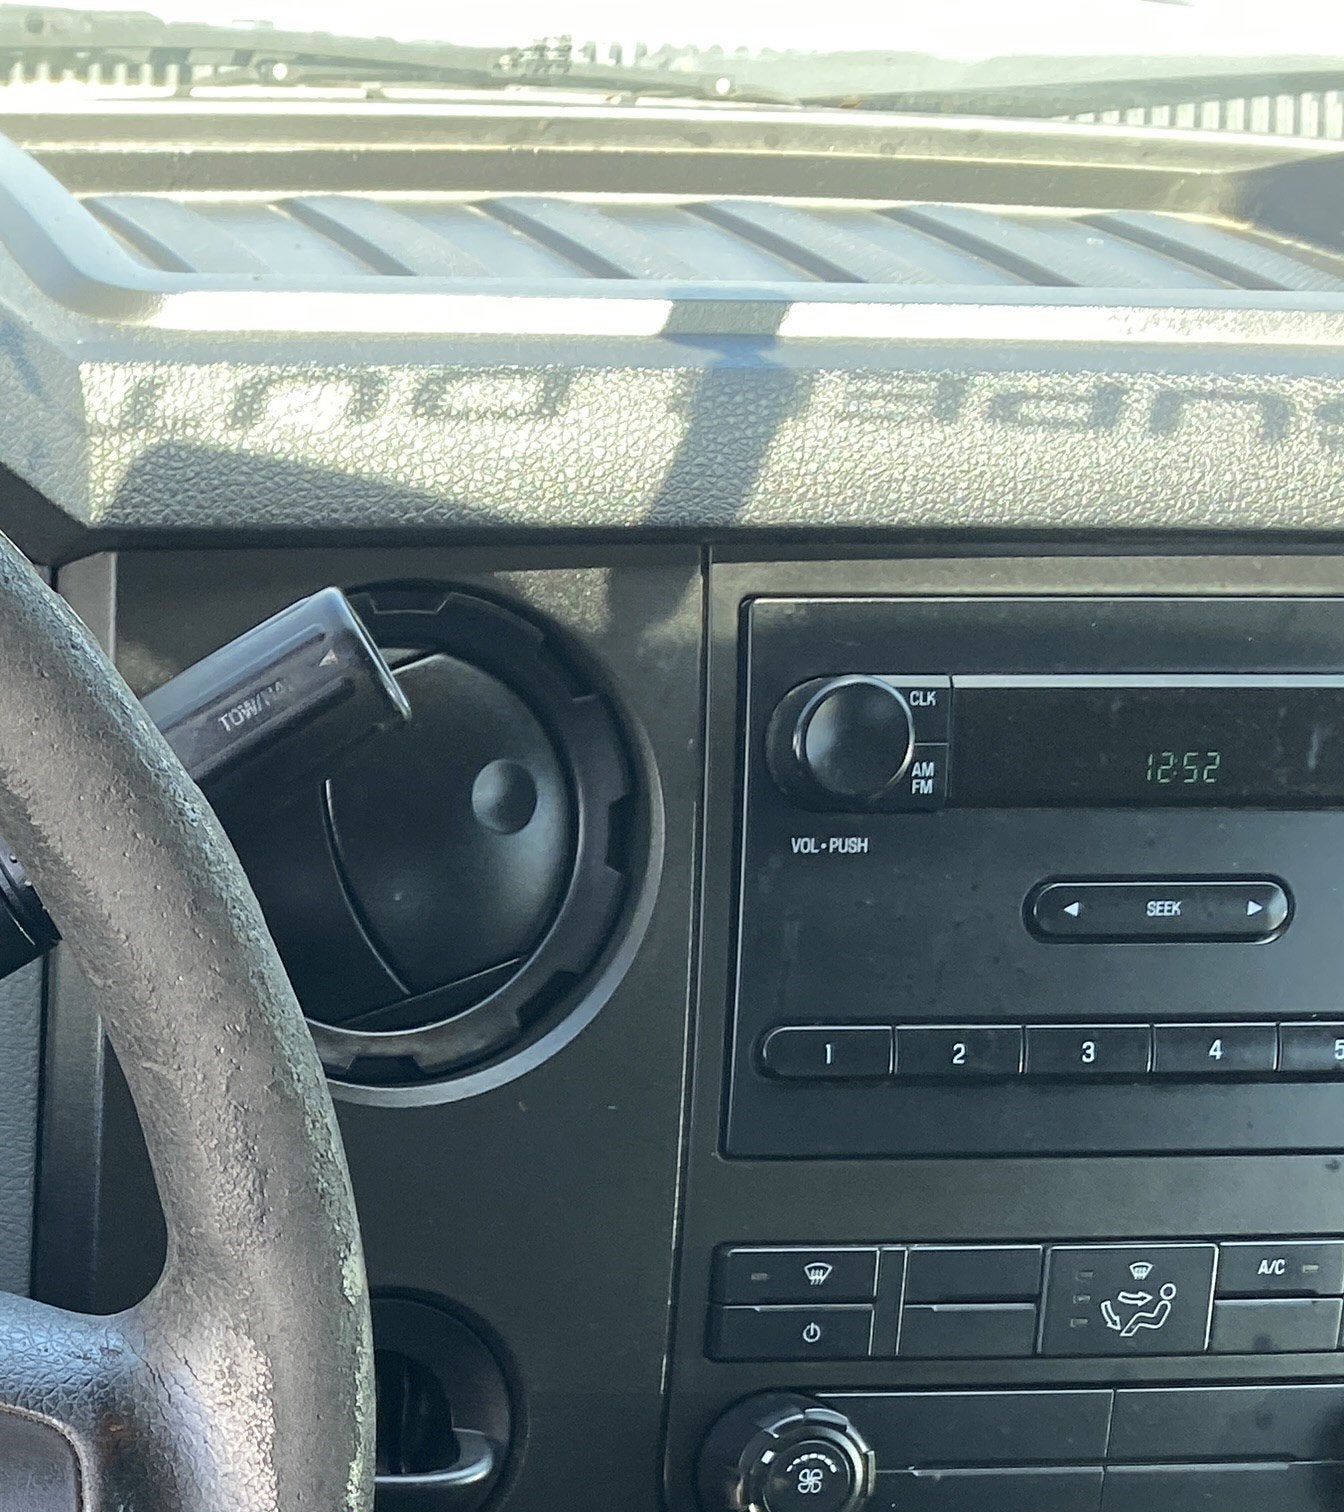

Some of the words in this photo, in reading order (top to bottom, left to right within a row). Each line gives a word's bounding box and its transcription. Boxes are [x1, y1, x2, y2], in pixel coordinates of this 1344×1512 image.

[909, 691, 936, 707] CLK
[912, 762, 934, 776] AM
[1146, 752, 1221, 783] 12:52
[912, 779, 933, 794] FM
[1146, 900, 1181, 916] SEEK
[825, 1043, 833, 1065] 1
[952, 1043, 966, 1065] 2
[1081, 1041, 1095, 1063] 3
[1208, 1039, 1223, 1060] 4
[1257, 1259, 1285, 1275] A/C
